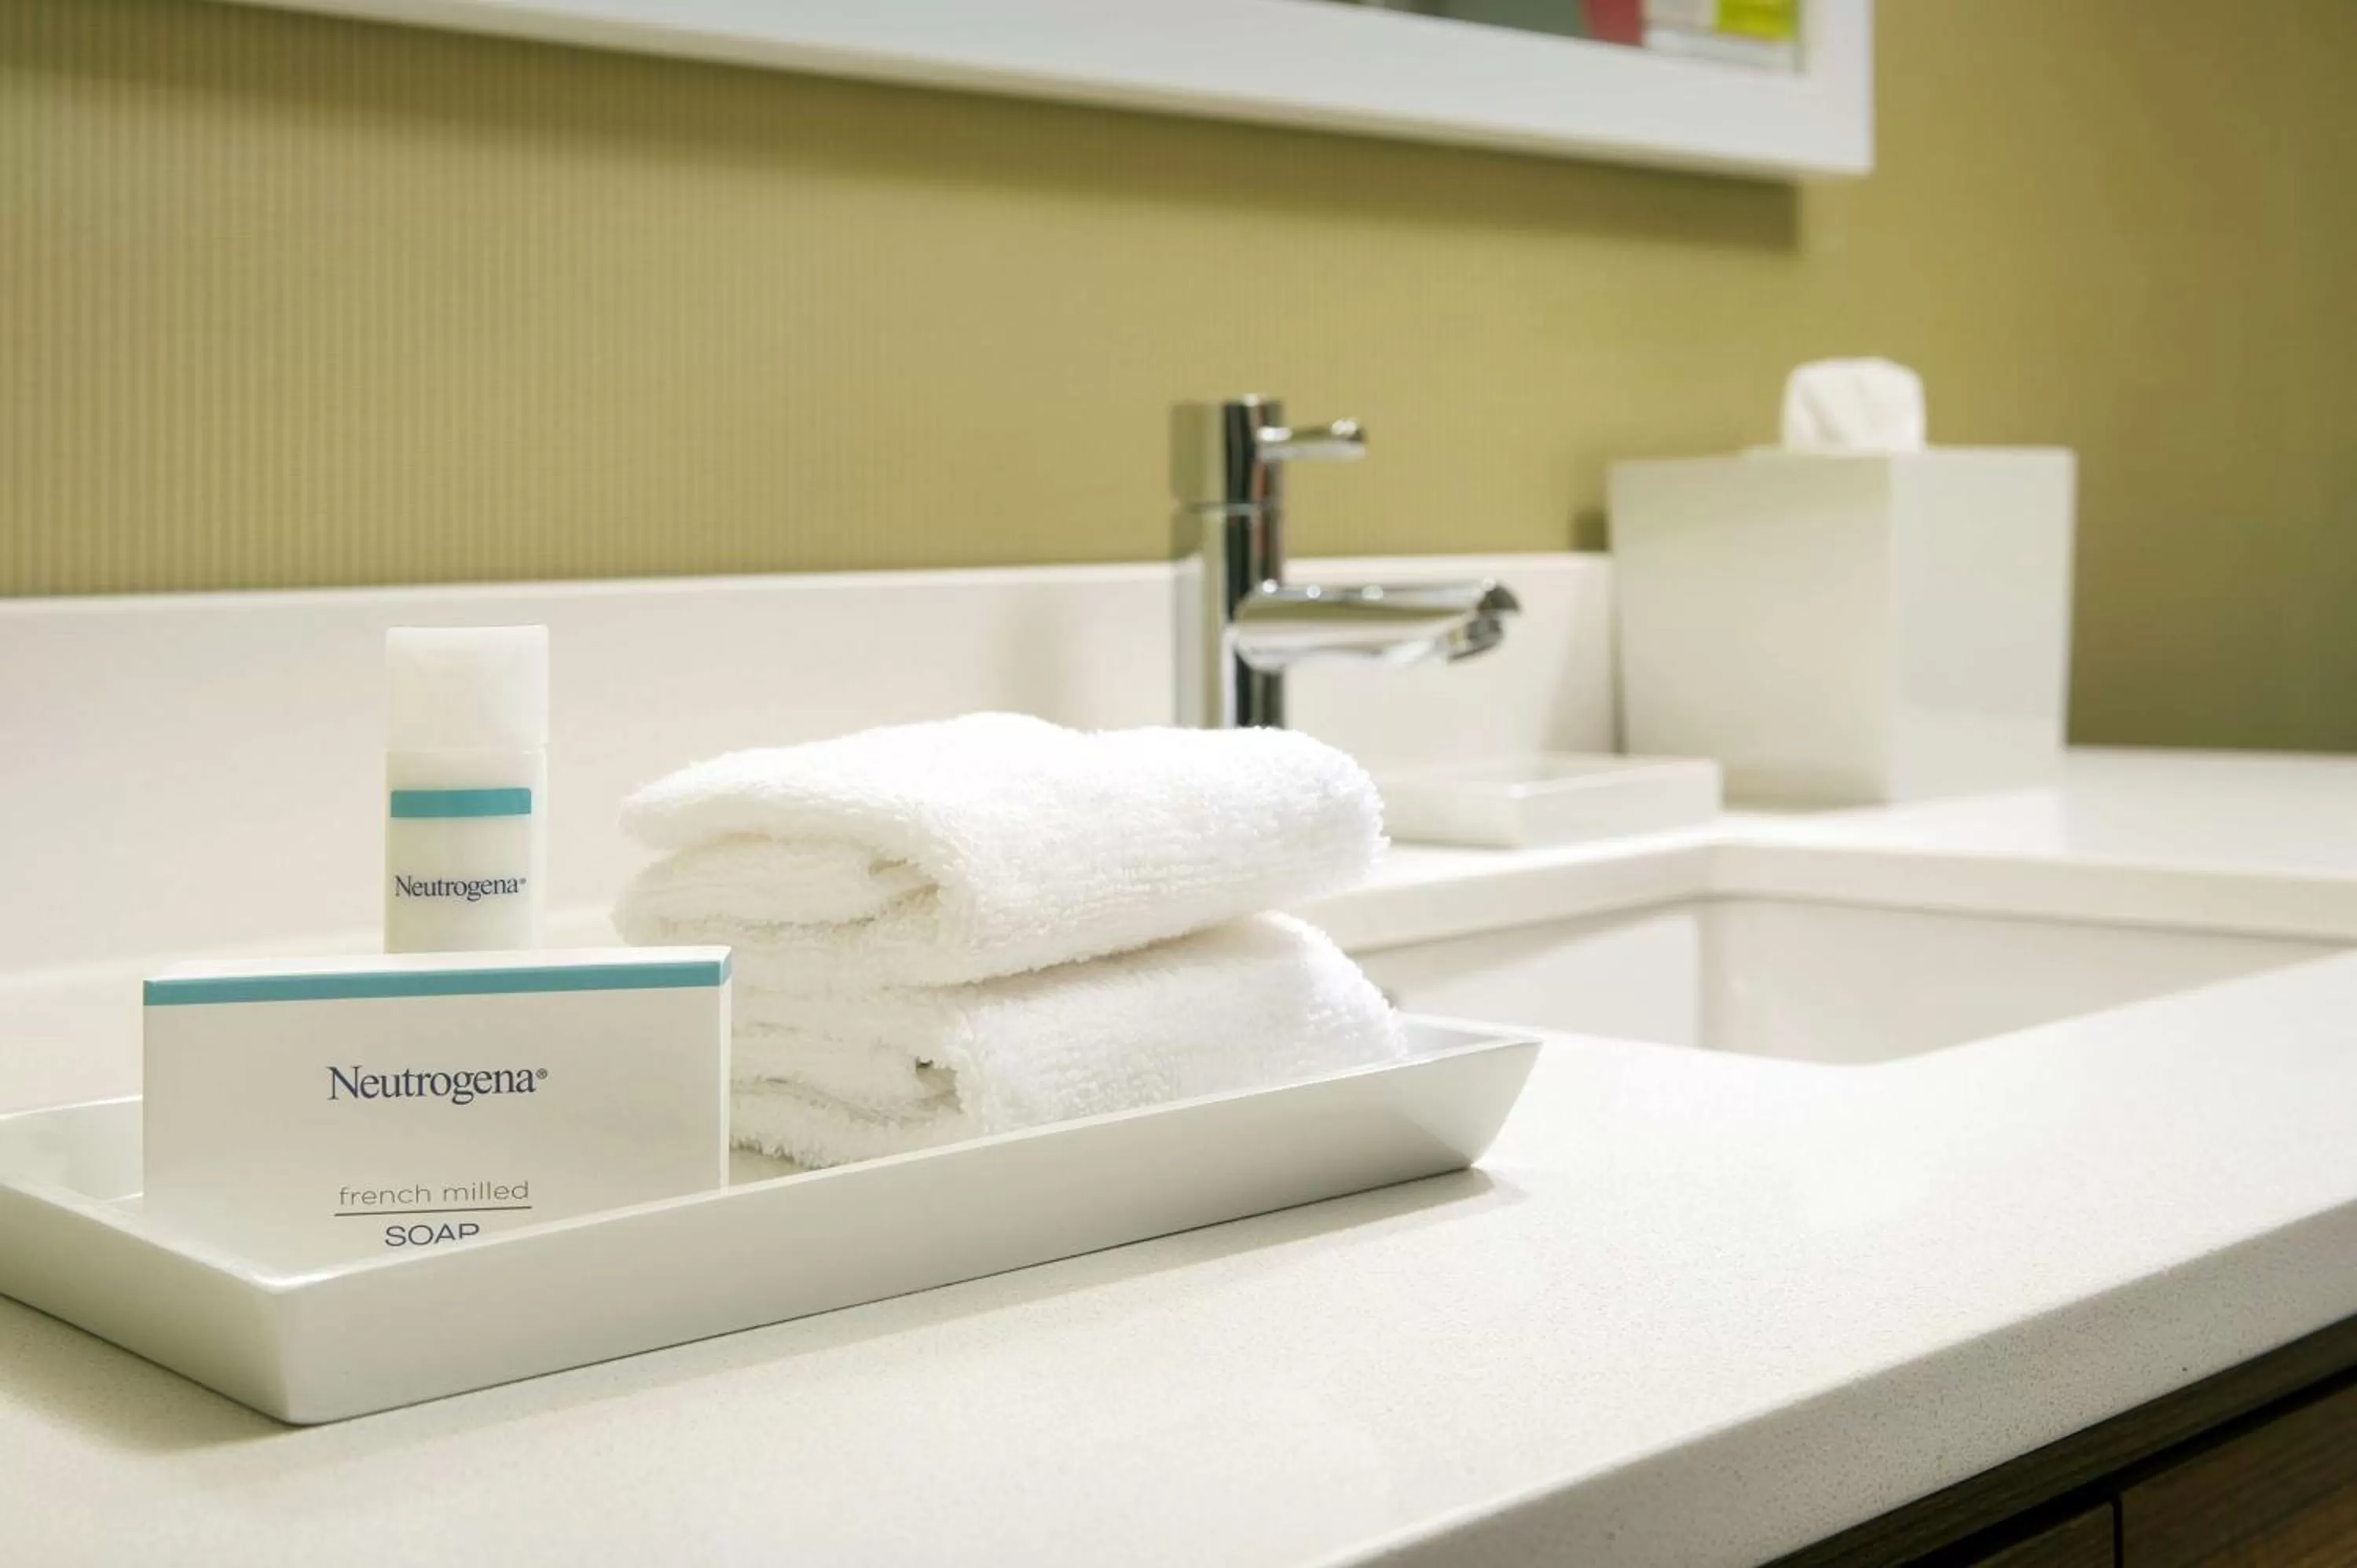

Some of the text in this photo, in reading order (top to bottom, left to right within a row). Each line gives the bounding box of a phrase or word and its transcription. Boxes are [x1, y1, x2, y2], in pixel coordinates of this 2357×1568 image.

[339, 1181, 529, 1205] french milled
[384, 1222, 480, 1247] SOAP
